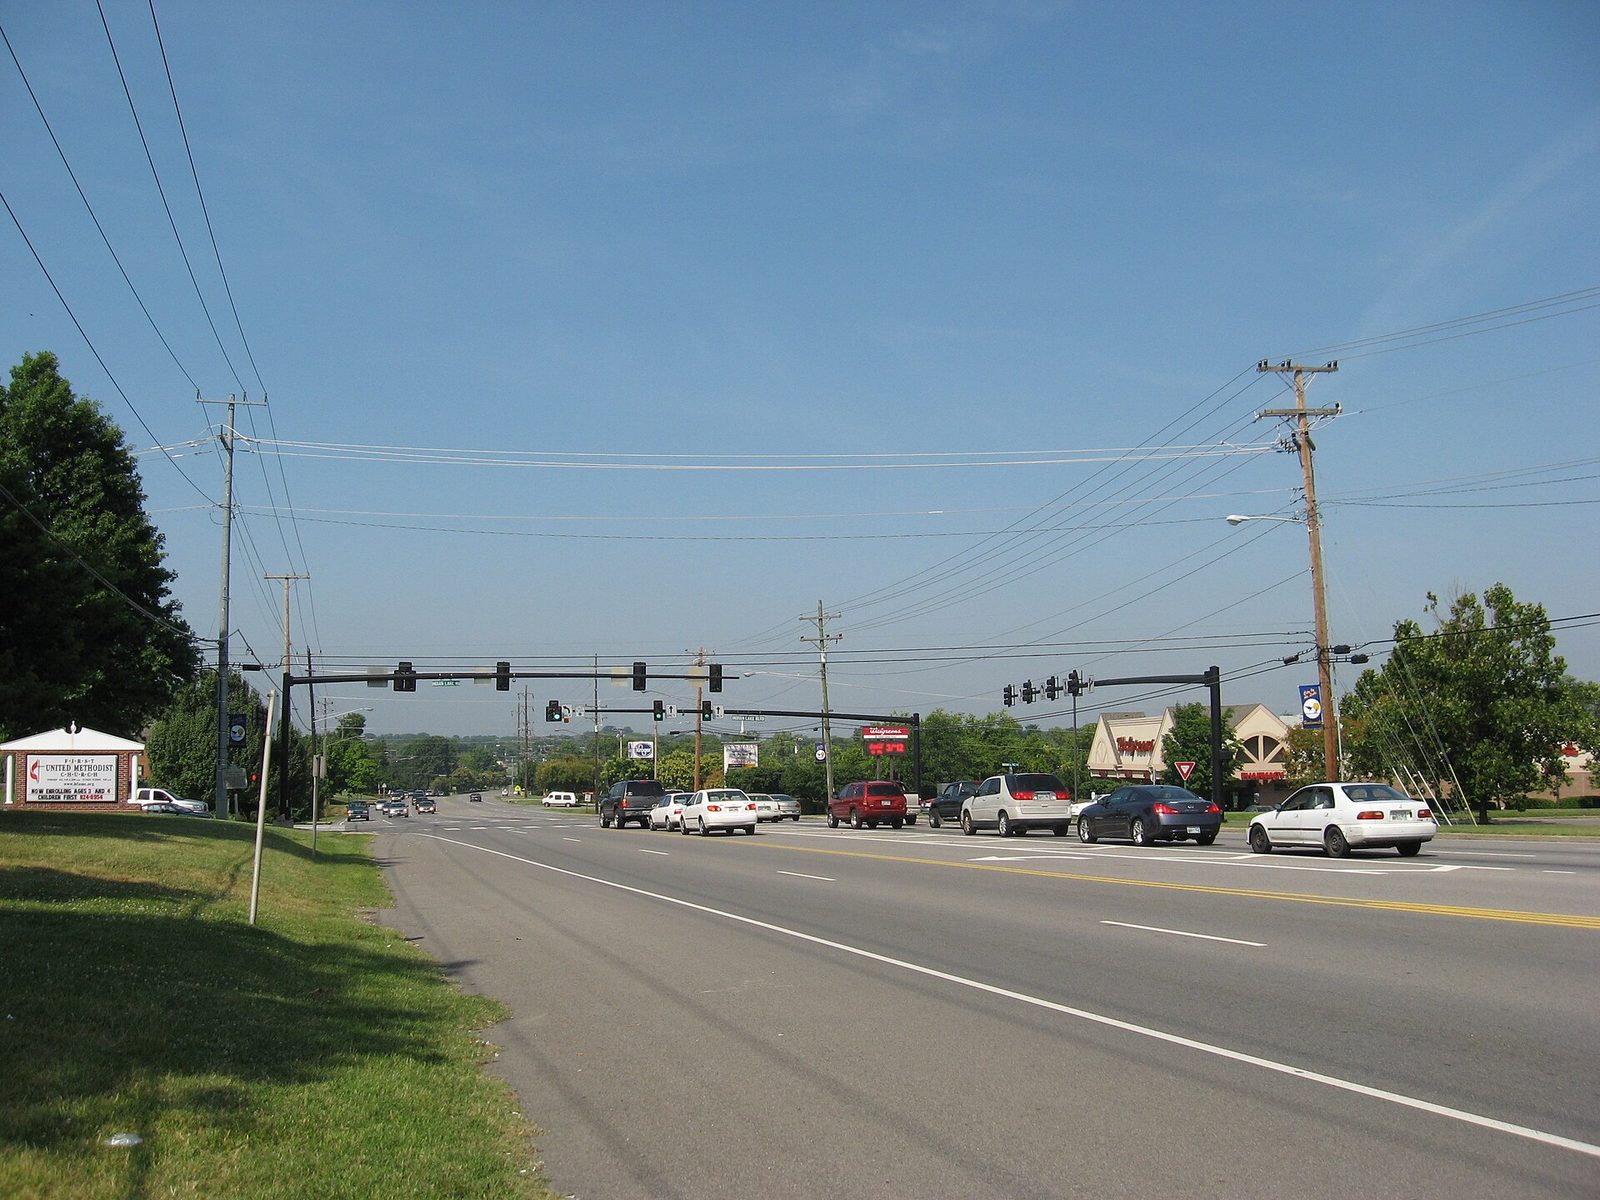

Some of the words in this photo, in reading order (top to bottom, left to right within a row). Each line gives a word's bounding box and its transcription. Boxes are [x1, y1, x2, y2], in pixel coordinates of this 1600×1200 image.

[869, 727, 902, 735] Walgreens
[45, 764, 71, 772] UNITED
[74, 764, 113, 772] METHODIST
